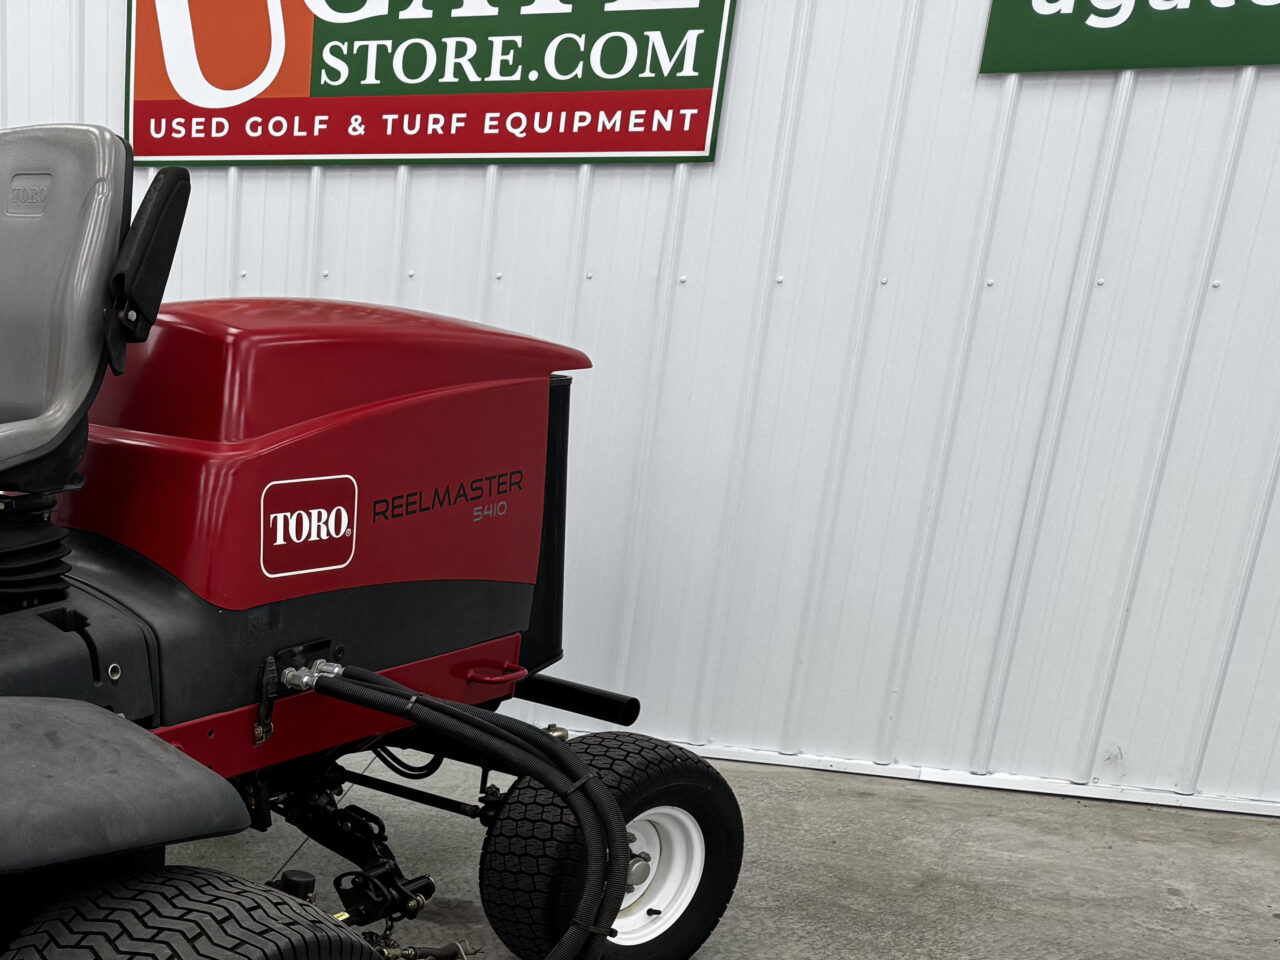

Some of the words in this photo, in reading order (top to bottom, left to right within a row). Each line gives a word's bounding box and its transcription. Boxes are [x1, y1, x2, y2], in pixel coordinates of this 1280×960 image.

[320, 29, 704, 86] STORE.COM
[149, 117, 230, 139] USED
[245, 115, 329, 137] GOLF
[347, 114, 366, 136] &
[382, 113, 467, 136] TURF
[483, 109, 699, 139] EQUIPMENT
[372, 469, 524, 523] REELMASTER
[473, 501, 508, 522] 5410
[269, 506, 349, 546] TORO
